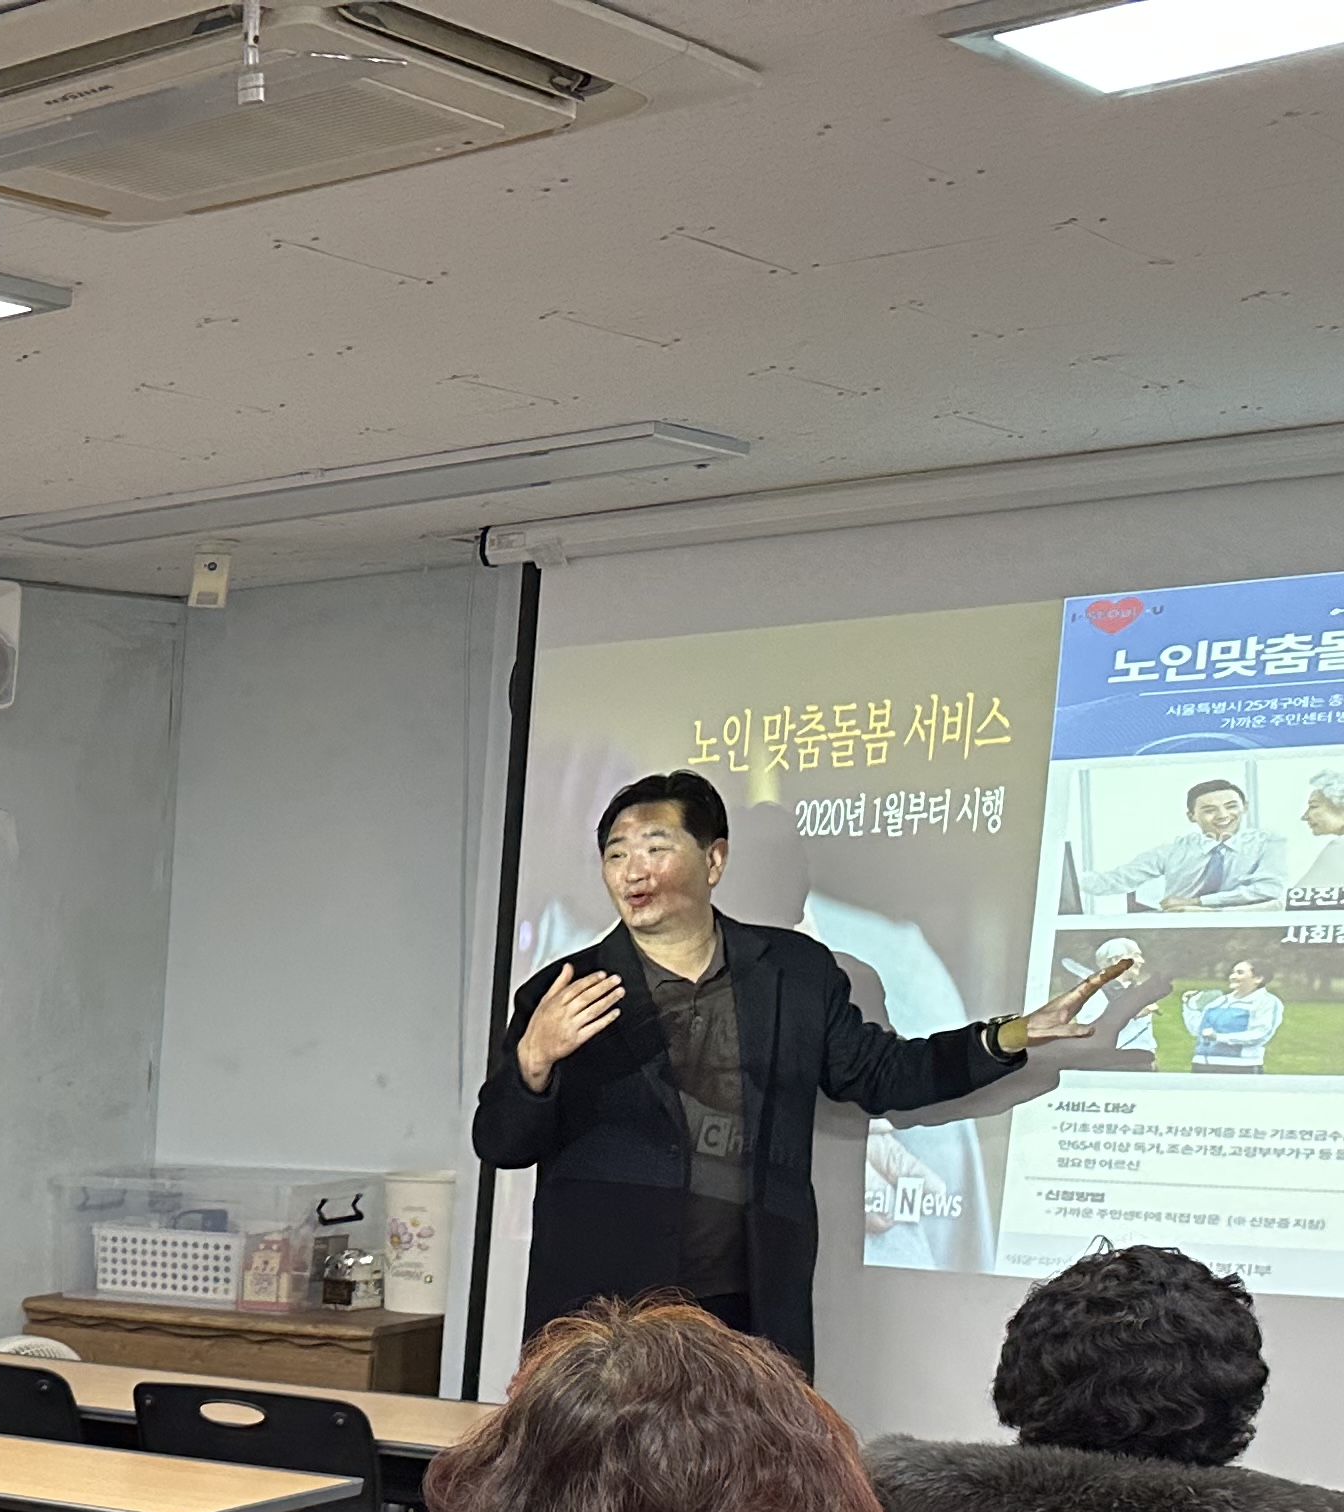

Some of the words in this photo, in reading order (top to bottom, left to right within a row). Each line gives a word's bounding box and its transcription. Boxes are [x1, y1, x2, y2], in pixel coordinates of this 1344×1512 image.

[1166, 699, 1242, 716] 서울특별시
[1220, 714, 1266, 729] 가까운
[1270, 710, 1332, 727] 주민센터
[687, 708, 753, 772] 노인
[763, 699, 896, 772] 맞춤돌봄
[904, 692, 1012, 761] 서비스
[795, 792, 866, 837] 2020년
[871, 788, 951, 837] 1월부터
[956, 786, 1006, 834] 시행
[1289, 887, 1344, 906] 안전
[1055, 1101, 1101, 1113] 서비스
[1104, 1102, 1136, 1114] 대상
[900, 1187, 962, 1217] News
